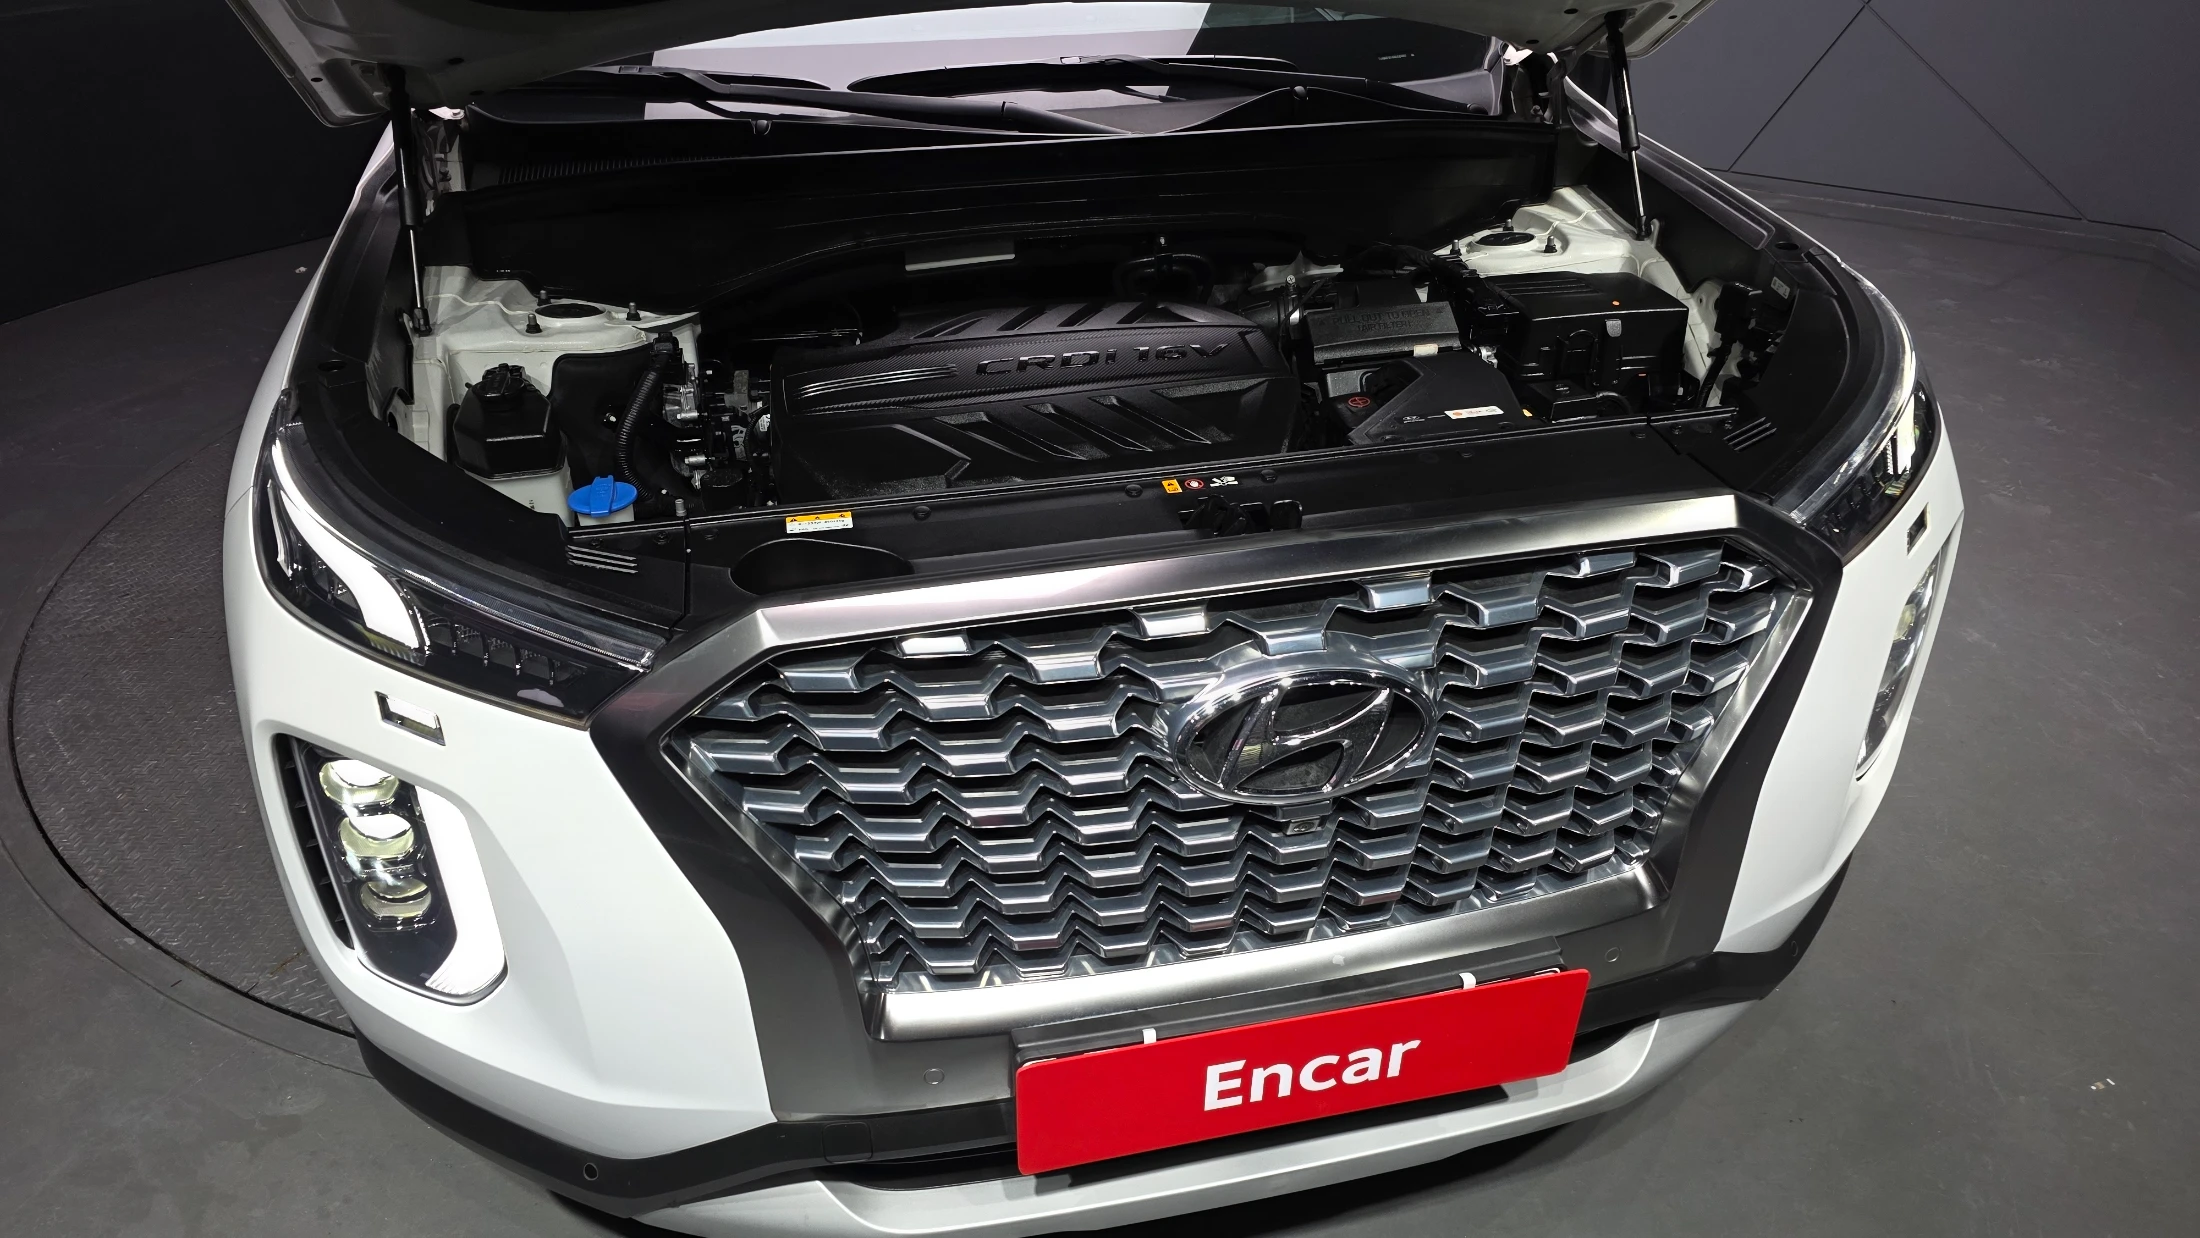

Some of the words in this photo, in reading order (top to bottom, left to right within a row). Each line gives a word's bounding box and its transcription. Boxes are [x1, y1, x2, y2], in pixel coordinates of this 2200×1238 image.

[1332, 313, 1360, 325] PULL
[1361, 311, 1383, 323] OUT
[1385, 310, 1400, 320] TO
[1401, 308, 1430, 319] OPEN
[1133, 343, 1231, 362] 16V
[1204, 1039, 1421, 1112] Encar
